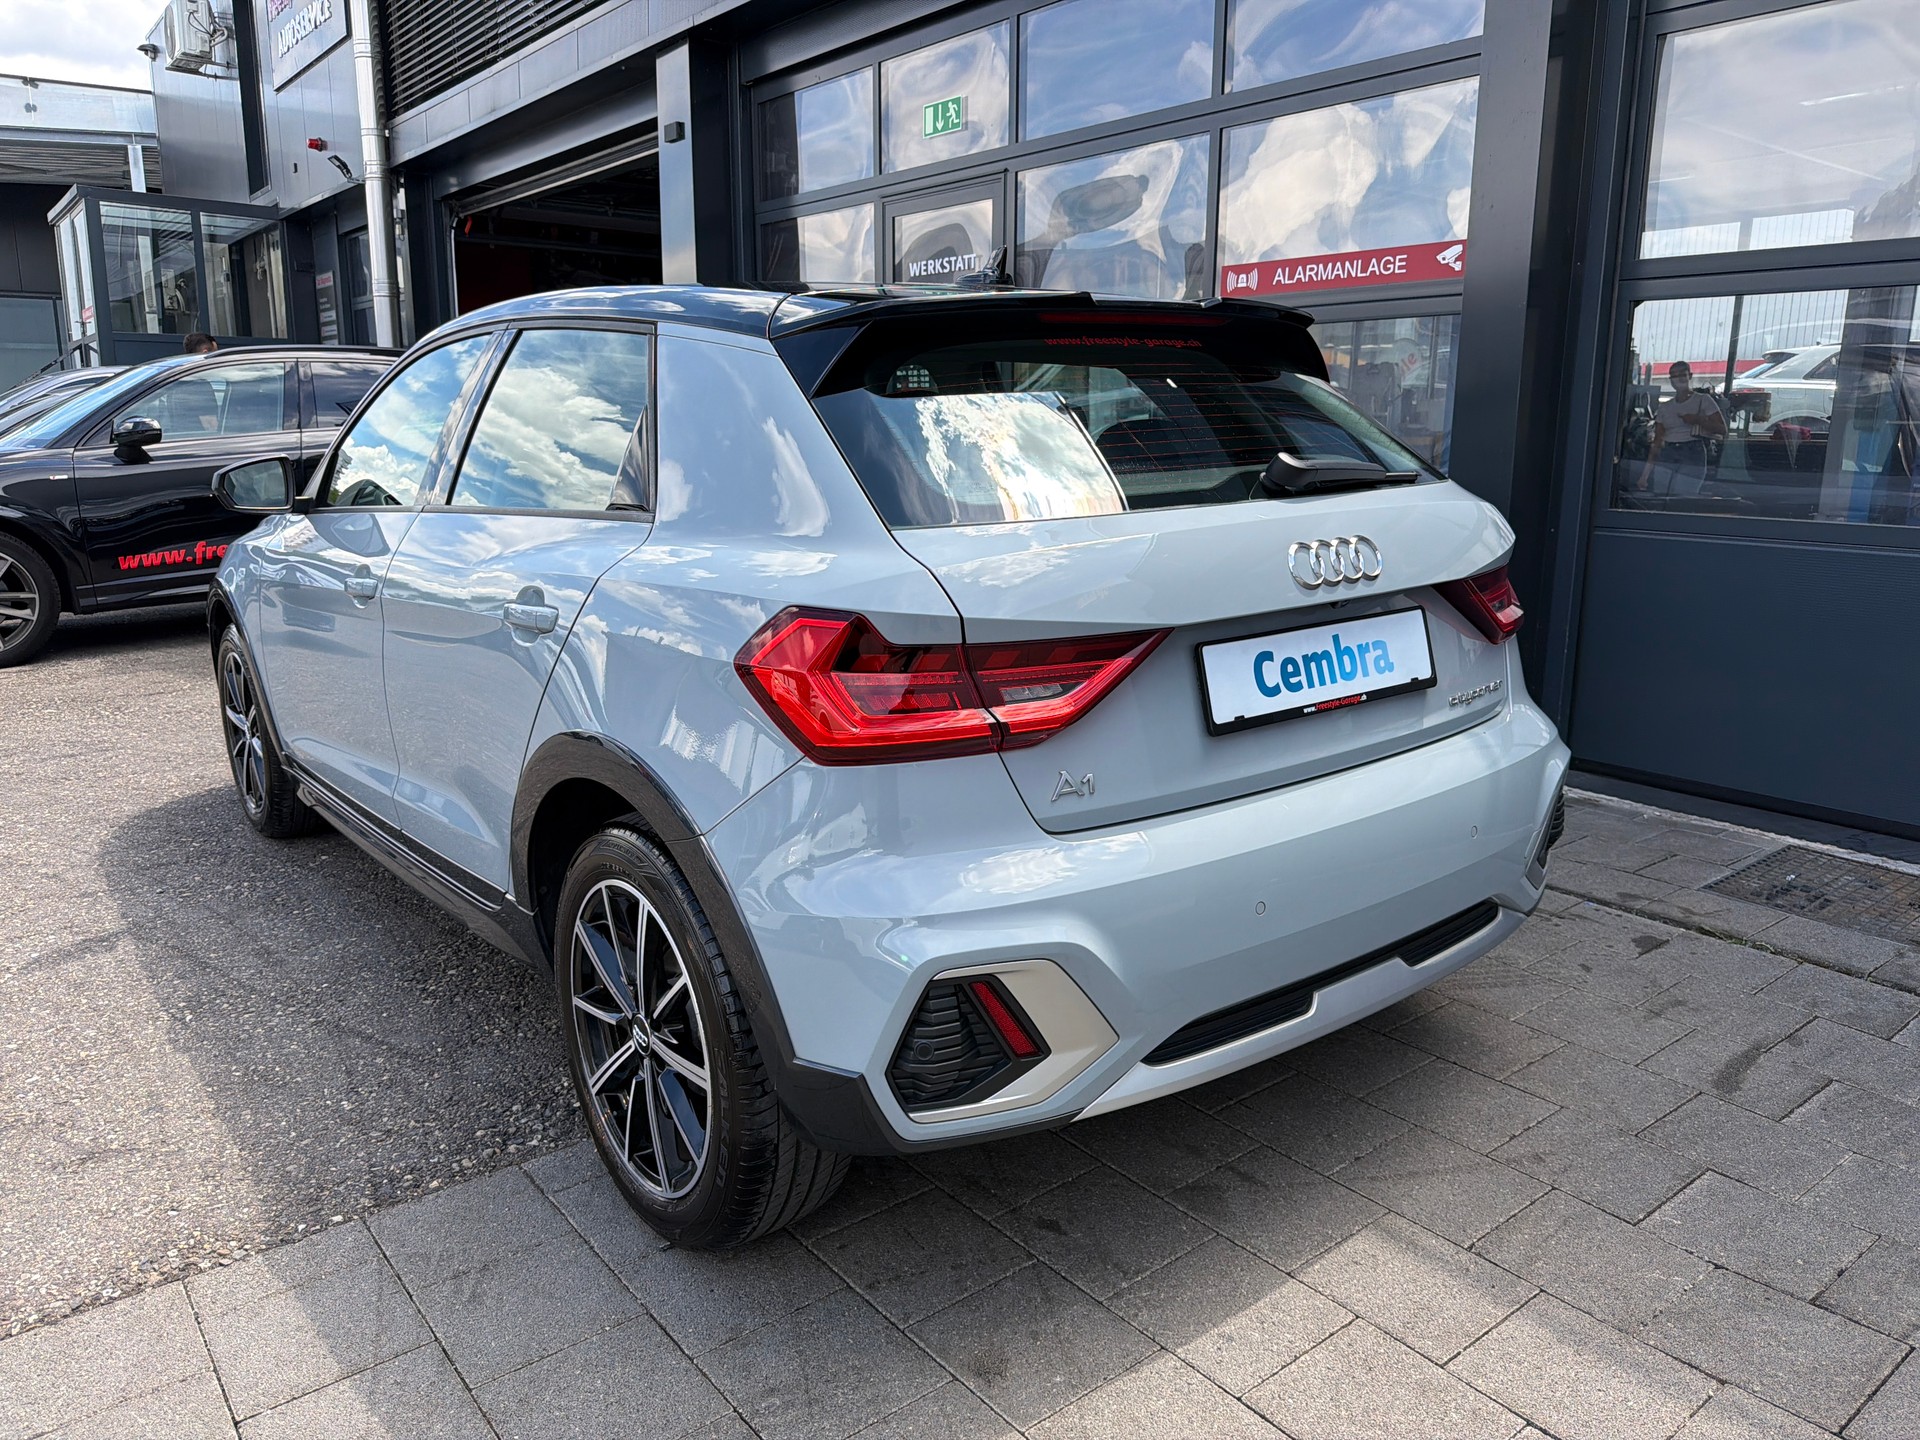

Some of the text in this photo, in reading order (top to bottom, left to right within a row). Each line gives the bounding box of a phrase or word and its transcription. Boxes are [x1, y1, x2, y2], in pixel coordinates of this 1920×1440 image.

[278, 0, 332, 58] AUTOSERVICE
[909, 253, 977, 277] WERKSTATT
[1272, 254, 1408, 286] ALARMANLAGE
[1044, 335, 1202, 348] www.freestyle-garage.ch
[1253, 633, 1395, 698] Cembra
[1051, 770, 1095, 802] A1
